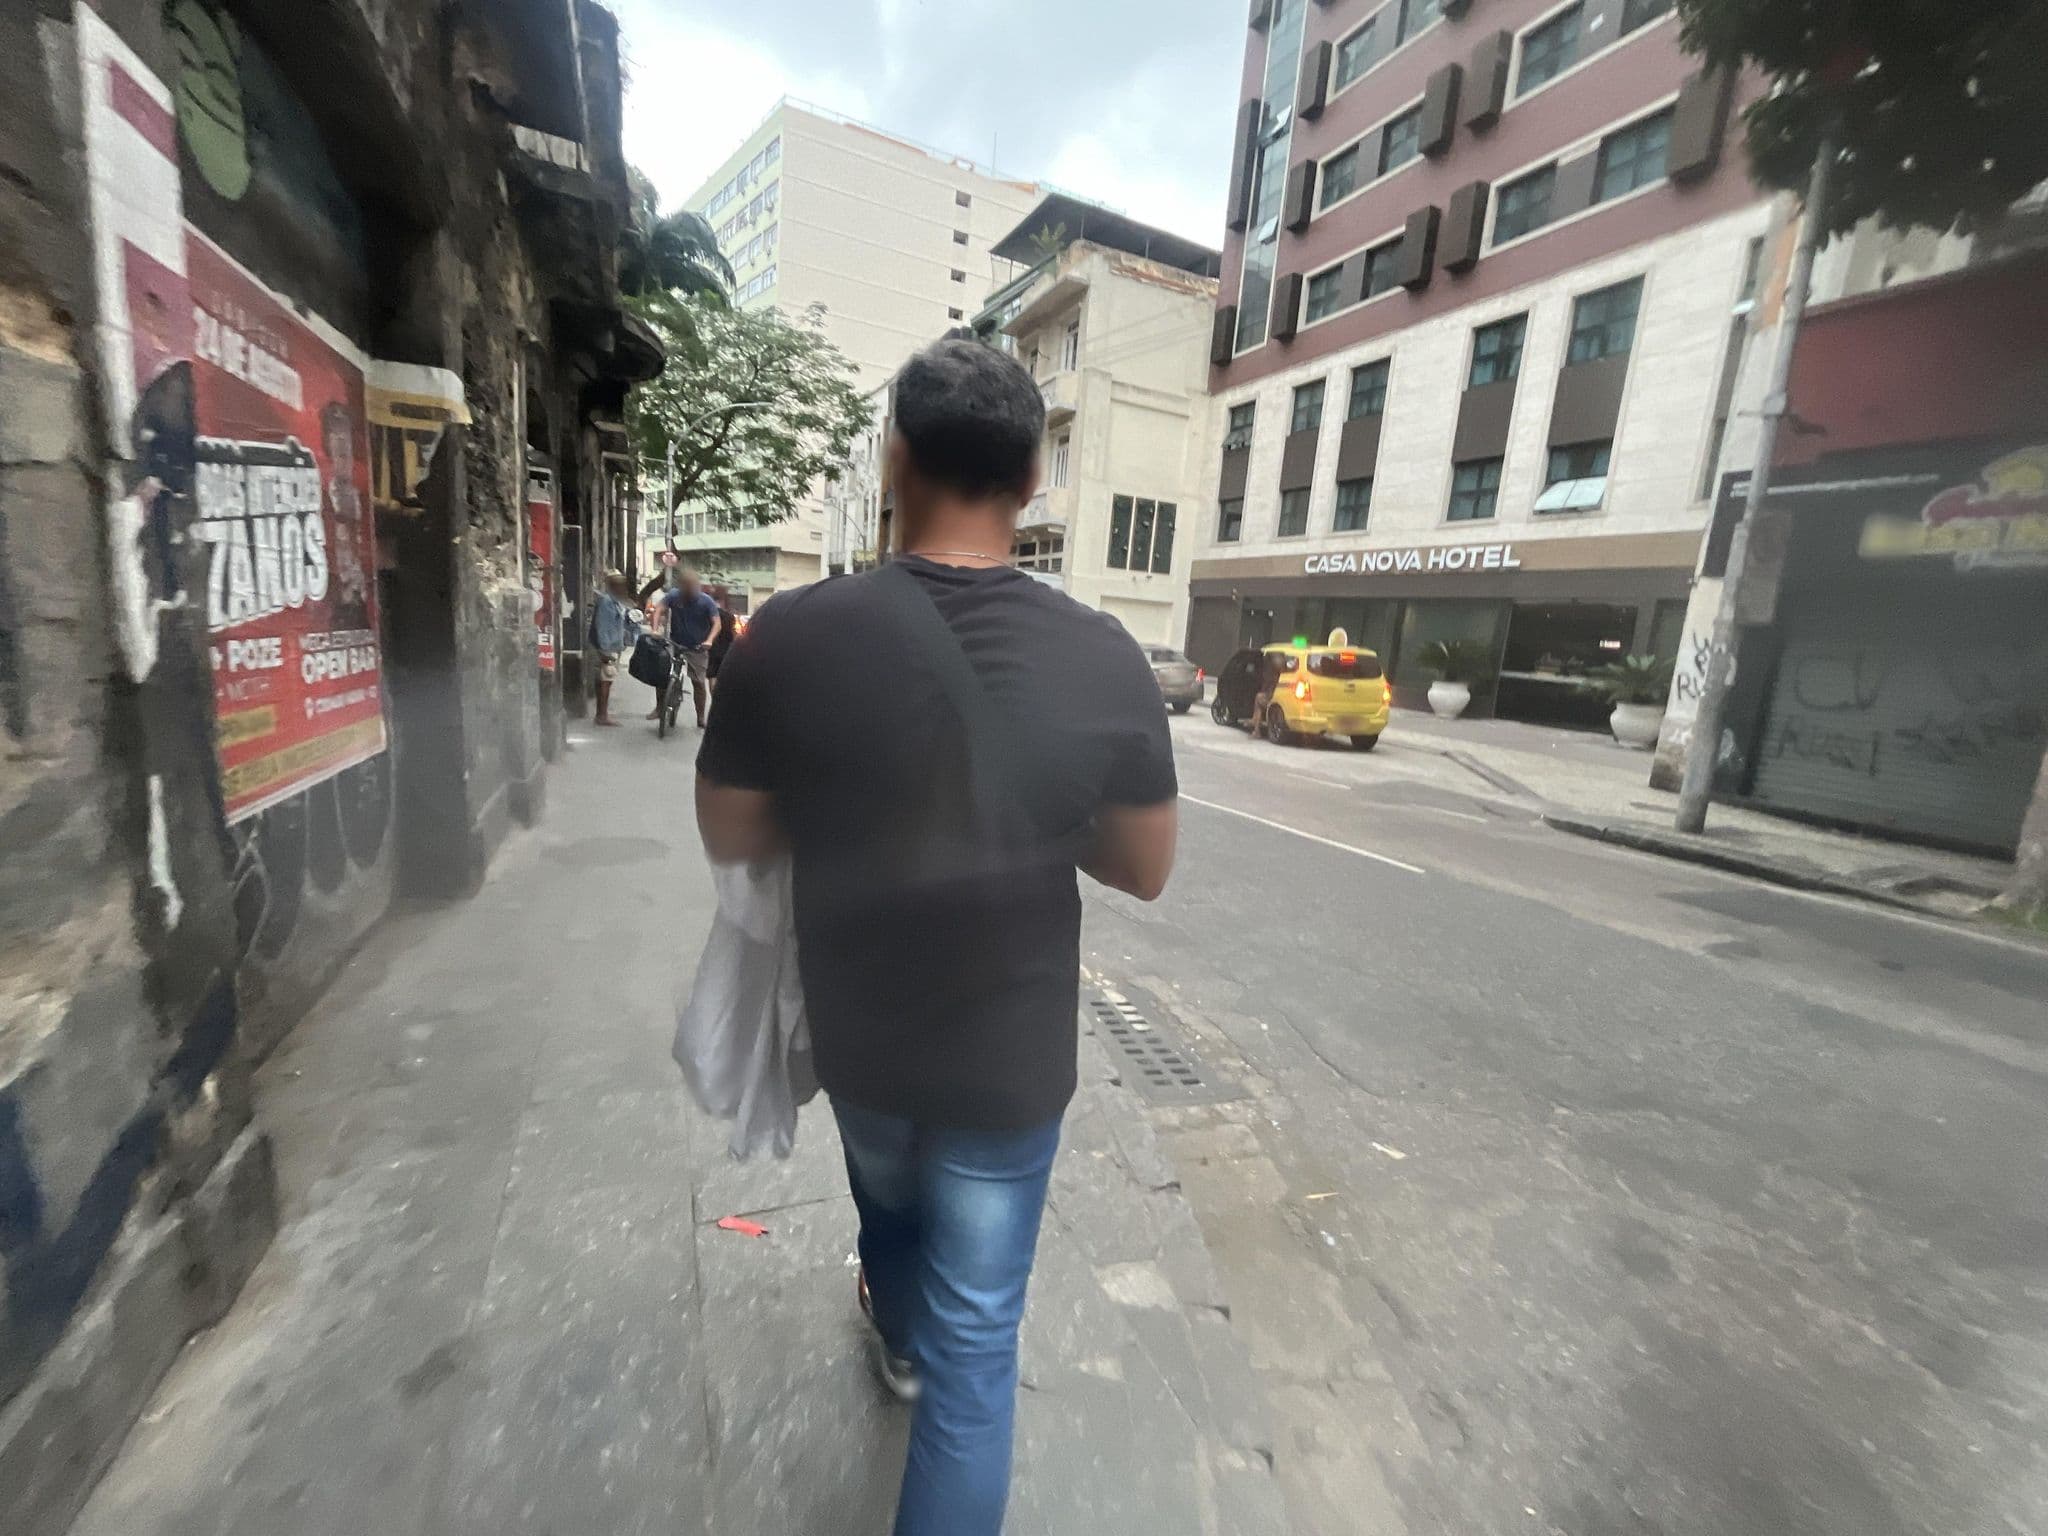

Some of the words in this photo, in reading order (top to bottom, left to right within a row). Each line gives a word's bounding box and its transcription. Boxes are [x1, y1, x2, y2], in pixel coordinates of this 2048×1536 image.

[1304, 553, 1357, 574] CASA
[1361, 549, 1422, 572] NOVA
[1427, 543, 1521, 570] HOTEL
[227, 636, 284, 672] POZE
[302, 650, 348, 685] OPEN
[350, 645, 377, 674] BAR
